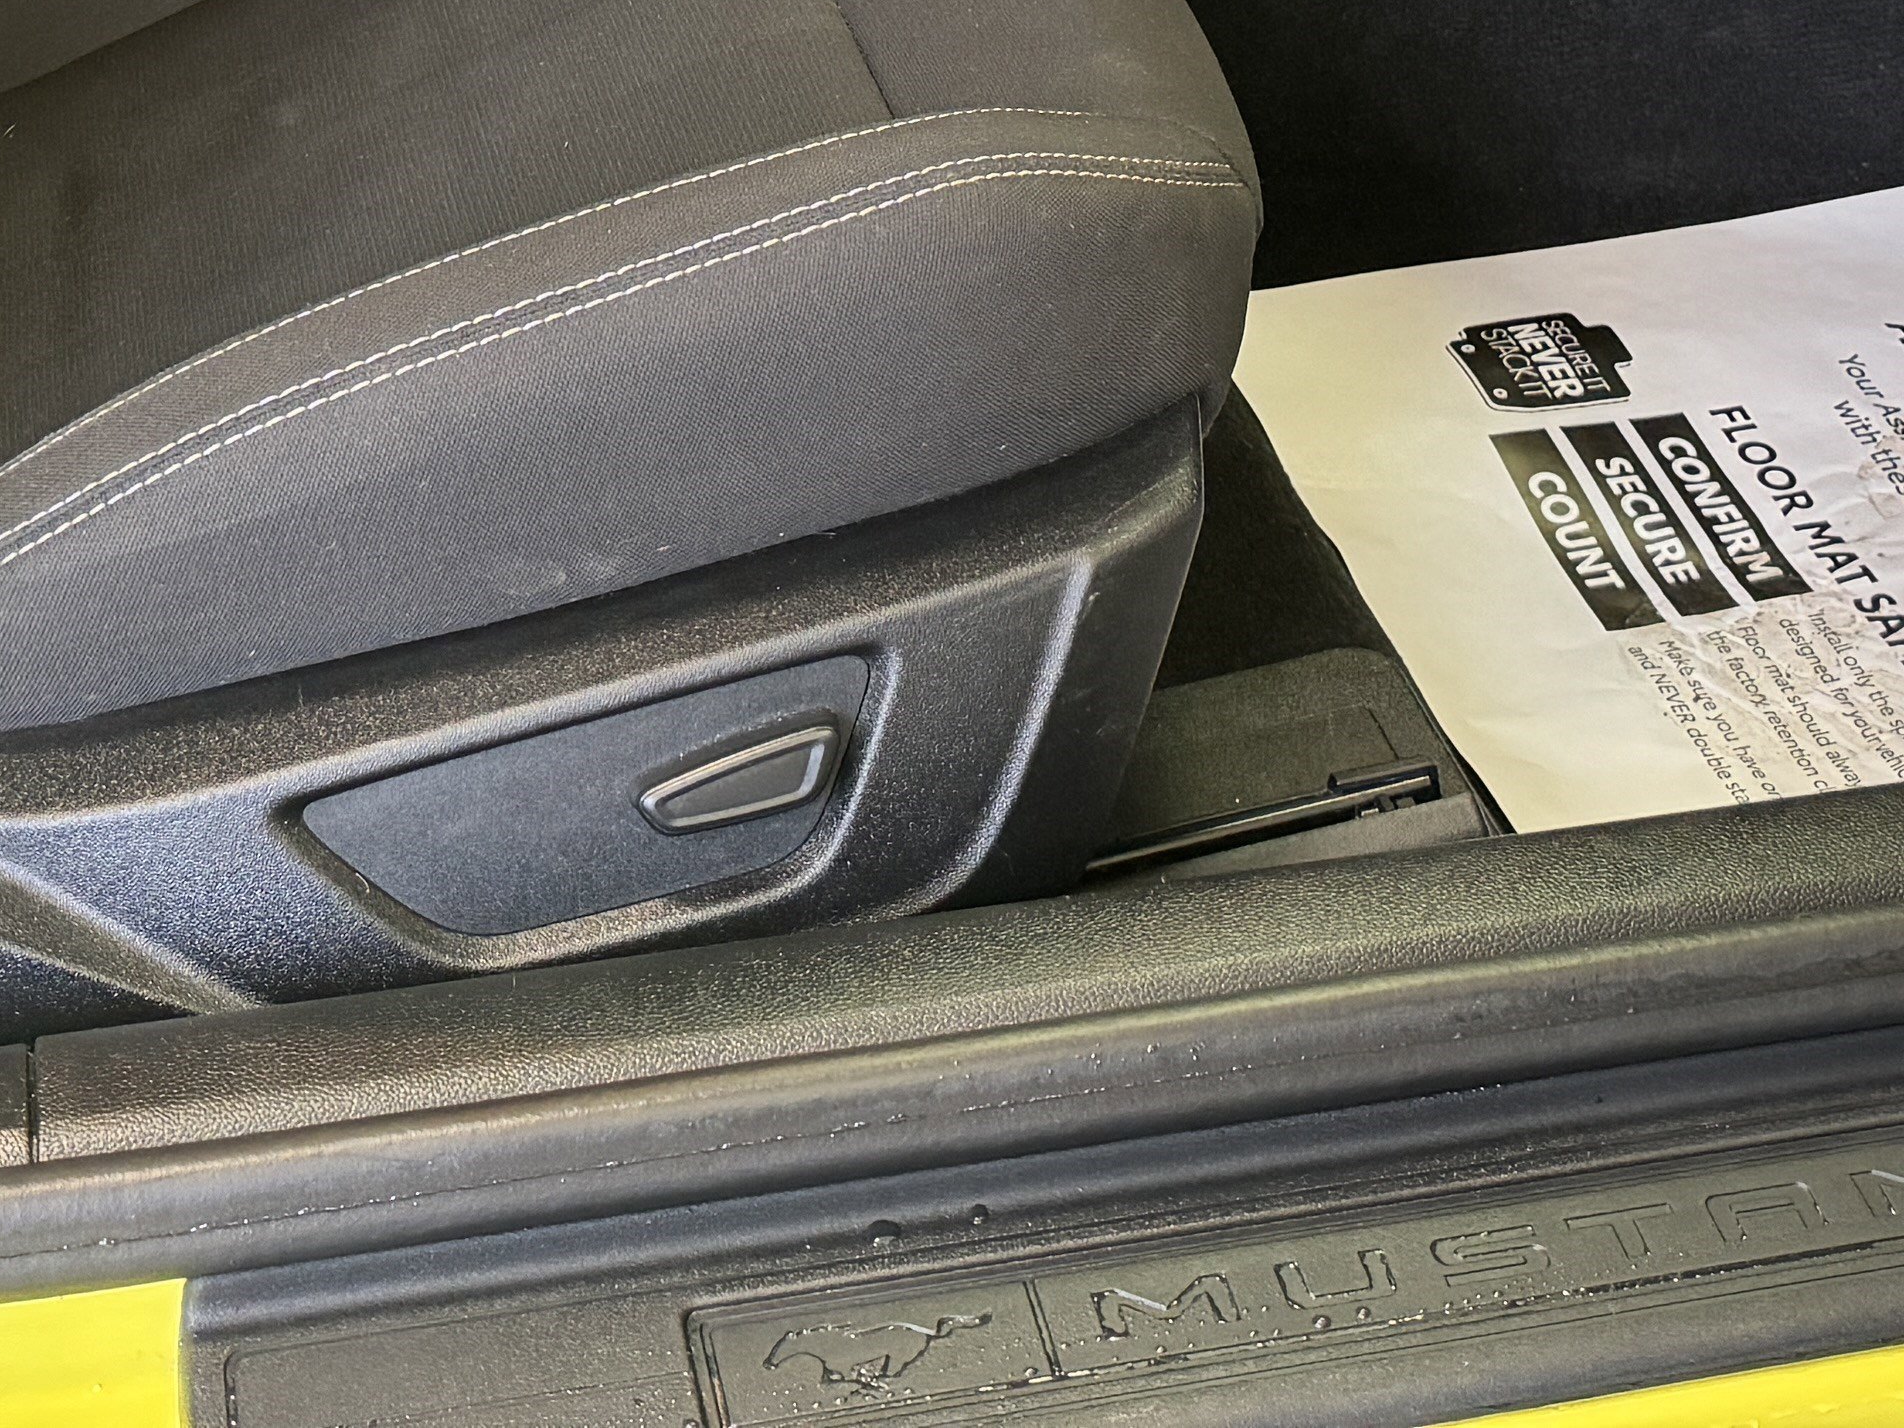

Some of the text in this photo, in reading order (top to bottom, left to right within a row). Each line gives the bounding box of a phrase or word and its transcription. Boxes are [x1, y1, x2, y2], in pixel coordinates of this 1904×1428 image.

[1481, 328, 1553, 400] STACK IT
[1507, 323, 1584, 400] NEVER
[1542, 320, 1611, 392] SECURE IT
[1838, 353, 1884, 398] Your
[1834, 400, 1881, 445] with
[1528, 471, 1626, 591] COUNT
[1595, 456, 1701, 585] SECURE
[1658, 436, 1784, 582] CONFIRM
[1709, 404, 1814, 517] FLOOR
[1793, 520, 1878, 584] MAT
[1779, 618, 1840, 684] designed
[1808, 609, 1854, 655] Install
[1843, 655, 1875, 687] only
[1869, 690, 1894, 717] the
[1628, 646, 1661, 670] and
[1650, 673, 1696, 724] NEVER
[1687, 727, 1731, 780] double
[1659, 640, 1694, 676] Make
[1688, 678, 1717, 712] sure
[1706, 712, 1739, 742] you
[1733, 745, 1766, 779] have
[1706, 629, 1732, 654] the
[1725, 657, 1770, 708] factory
[1763, 710, 1818, 777] retention
[1764, 664, 1795, 694] mat
[1787, 695, 1837, 747] should
[1831, 687, 1854, 708] for
[1842, 710, 1881, 746] your
